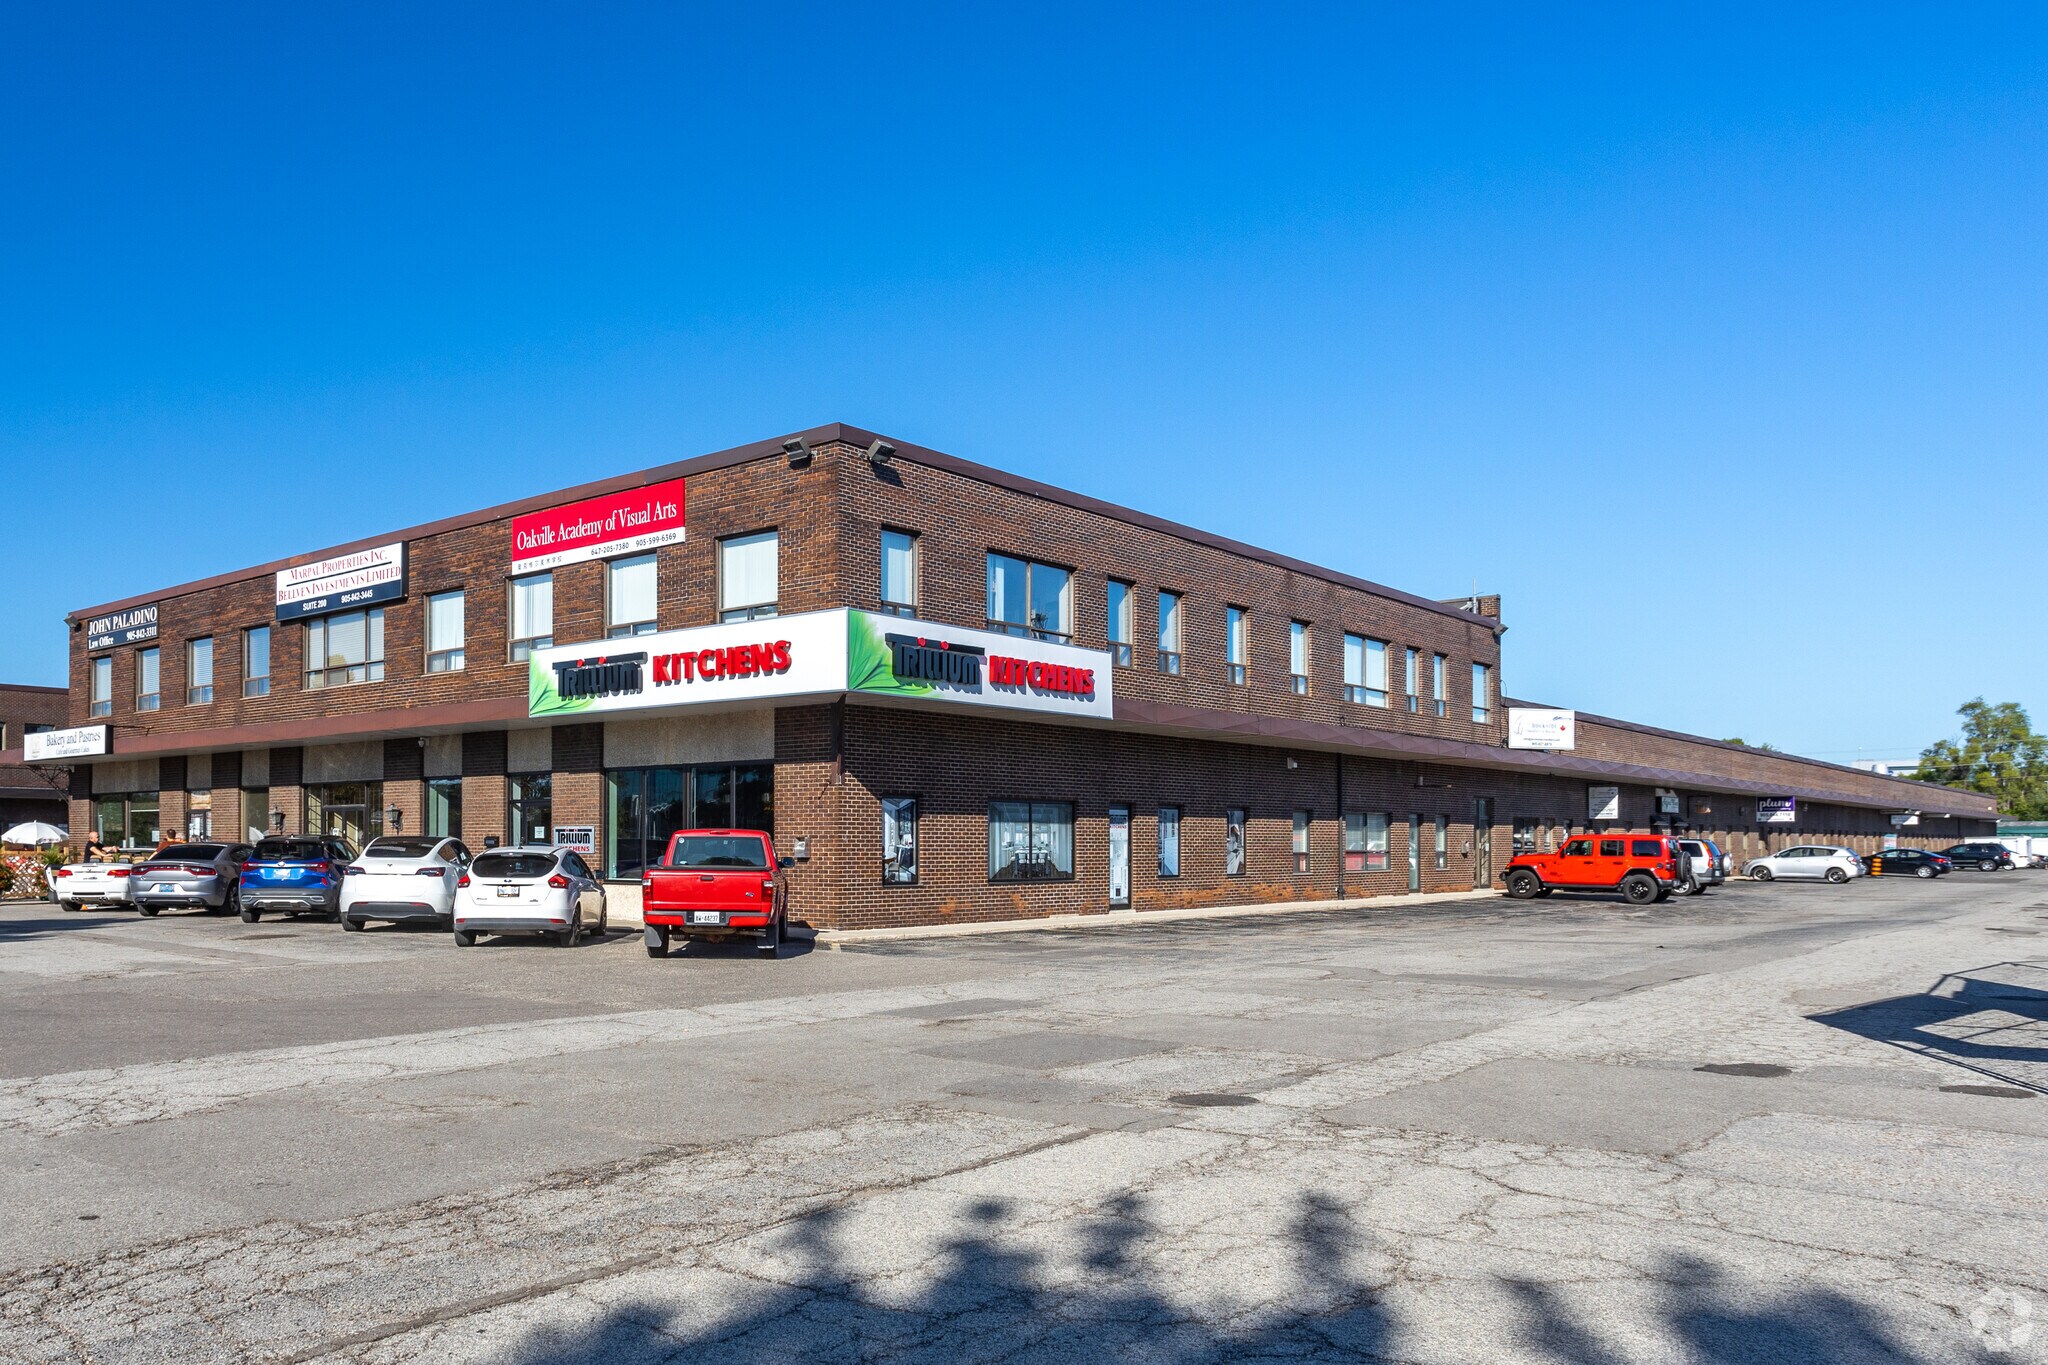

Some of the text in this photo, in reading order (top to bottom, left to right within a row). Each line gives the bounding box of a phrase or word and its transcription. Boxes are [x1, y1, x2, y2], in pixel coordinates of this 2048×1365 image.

[517, 501, 677, 550] Oakville Academy of Visual Arts
[591, 532, 677, 556] 647-205-7380 905-599-6369
[312, 574, 364, 594] INVESTMENTS
[366, 566, 401, 583] LIMITED
[302, 601, 317, 611] SUITE
[317, 599, 327, 608] 200
[88, 607, 157, 636] JOHN PALADINO
[89, 640, 99, 649] Law
[99, 636, 114, 646] Office
[652, 640, 791, 685] KITCHENS
[989, 655, 1095, 695] KITCHENS
[46, 731, 101, 748] Bakery and Pastries
